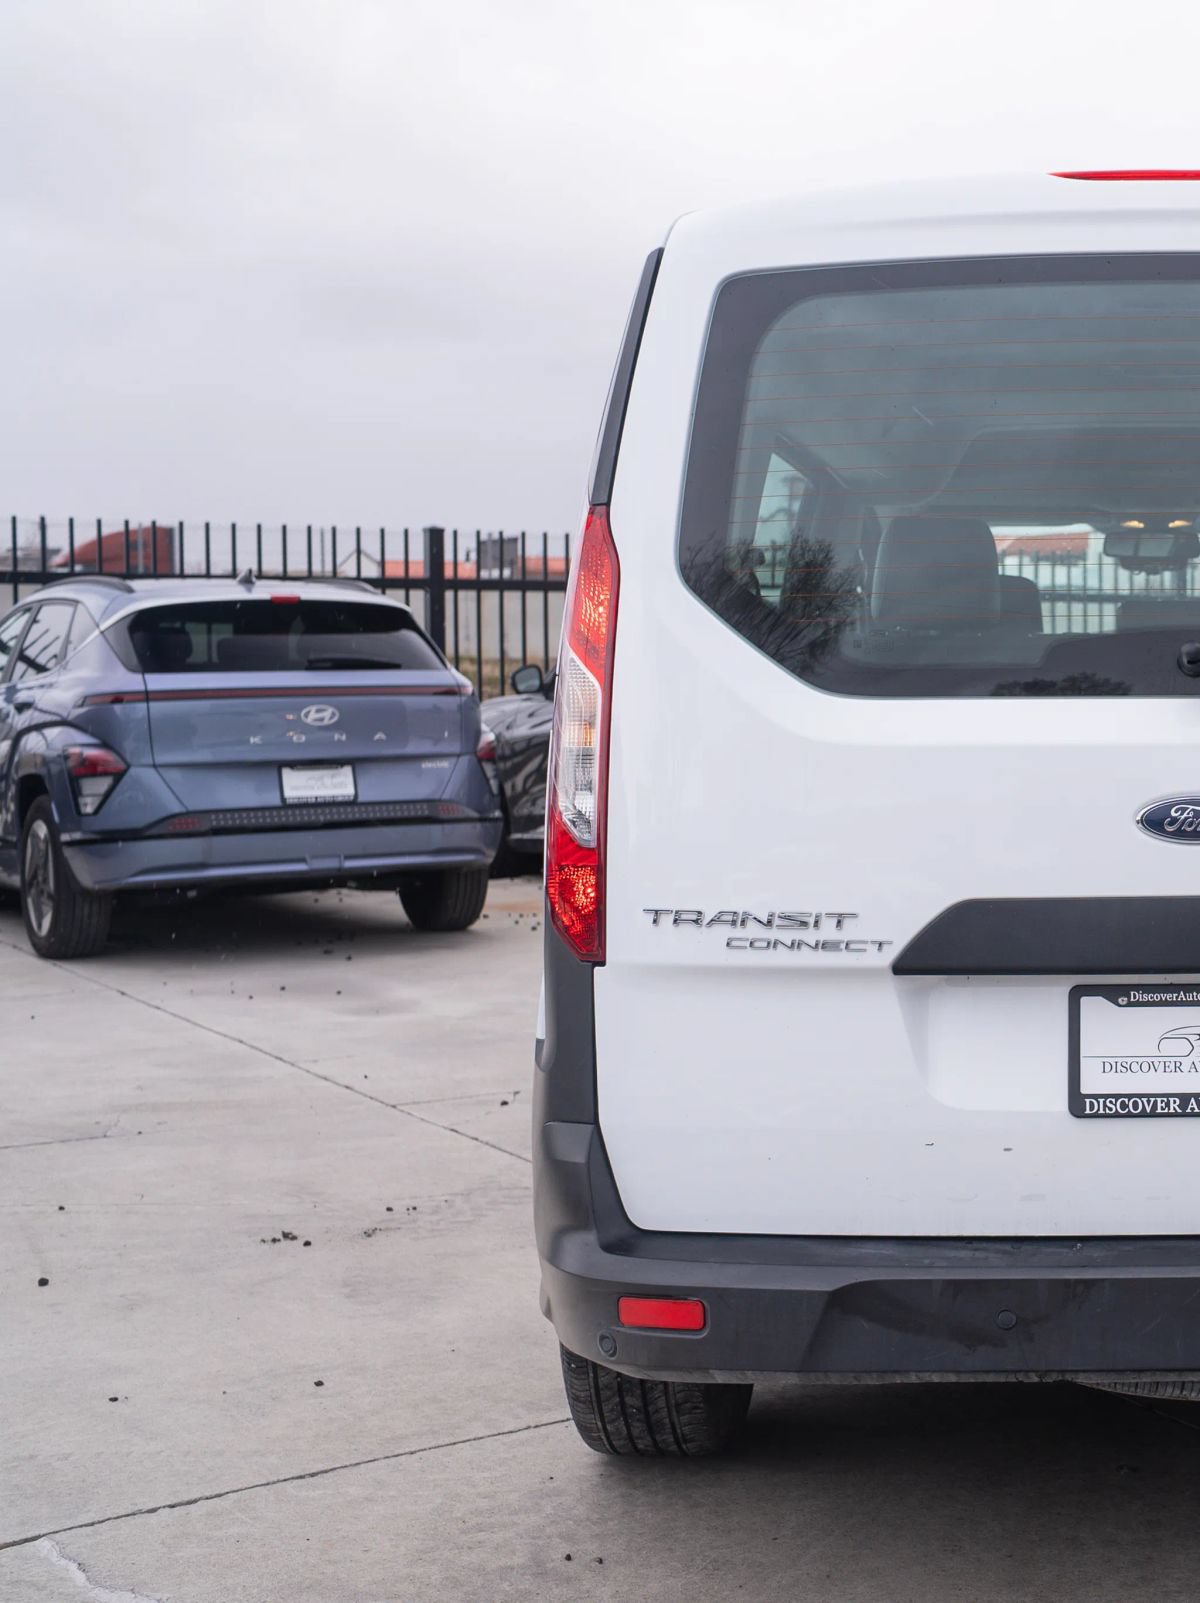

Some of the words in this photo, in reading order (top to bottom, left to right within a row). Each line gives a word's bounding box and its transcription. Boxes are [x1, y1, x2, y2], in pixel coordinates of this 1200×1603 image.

[249, 731, 387, 745] KONA
[642, 908, 859, 931] TRANSIT
[725, 937, 893, 953] CONNECT
[1101, 1060, 1184, 1074] DISCOVER
[1083, 1096, 1182, 1114] DISCOVER
